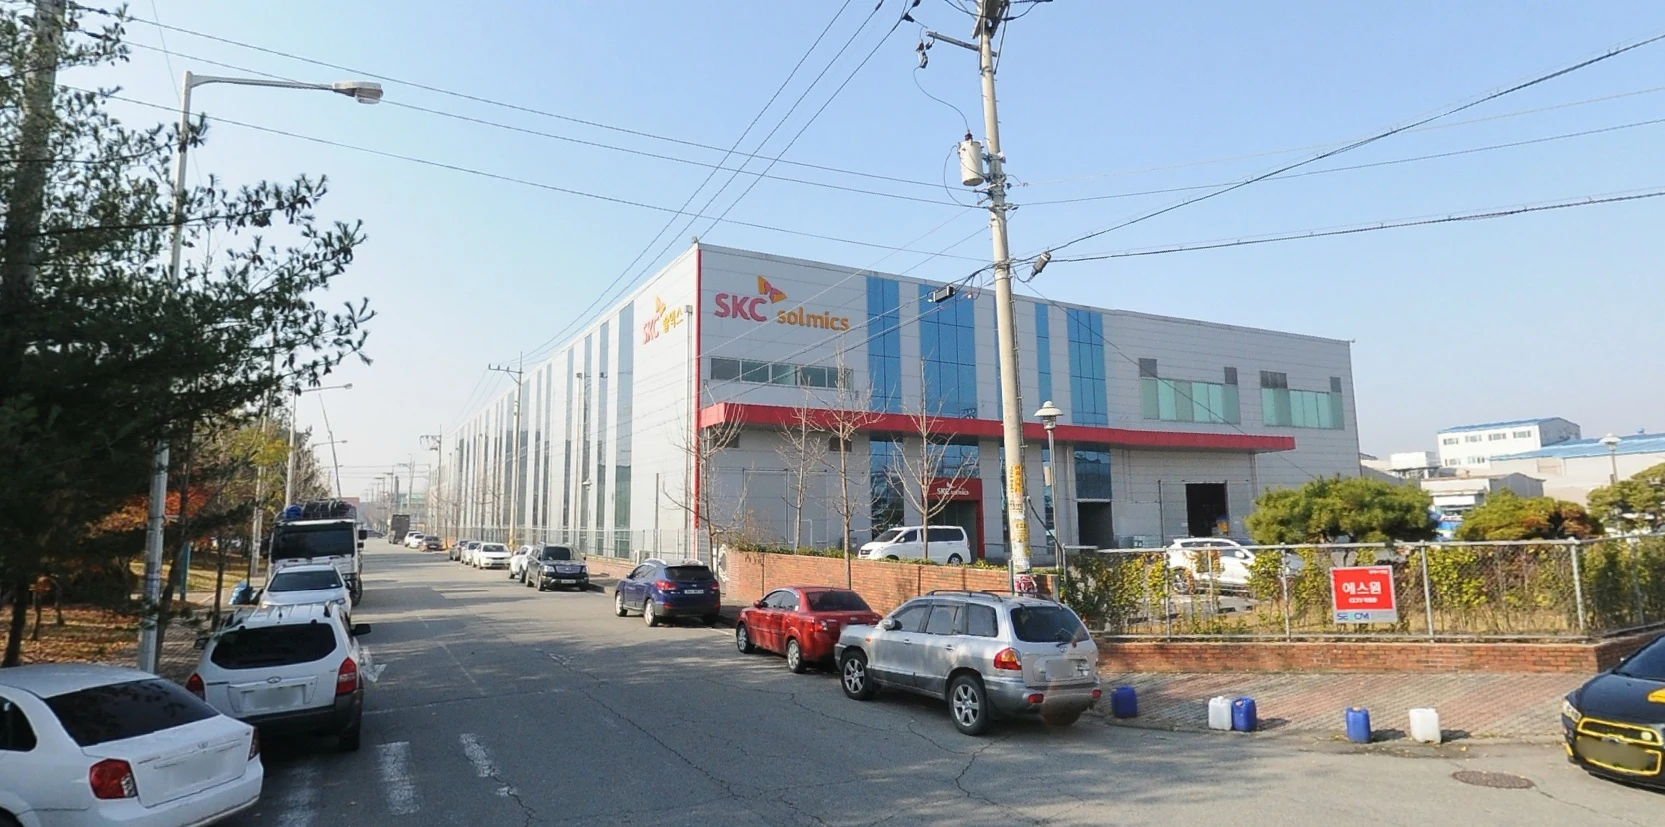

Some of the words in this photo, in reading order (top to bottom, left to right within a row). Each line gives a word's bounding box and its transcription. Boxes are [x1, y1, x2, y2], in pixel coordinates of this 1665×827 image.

[714, 293, 767, 322] SKC
[776, 307, 850, 332] solmics
[643, 315, 660, 345] SKC
[1341, 581, 1382, 596] 에스원
